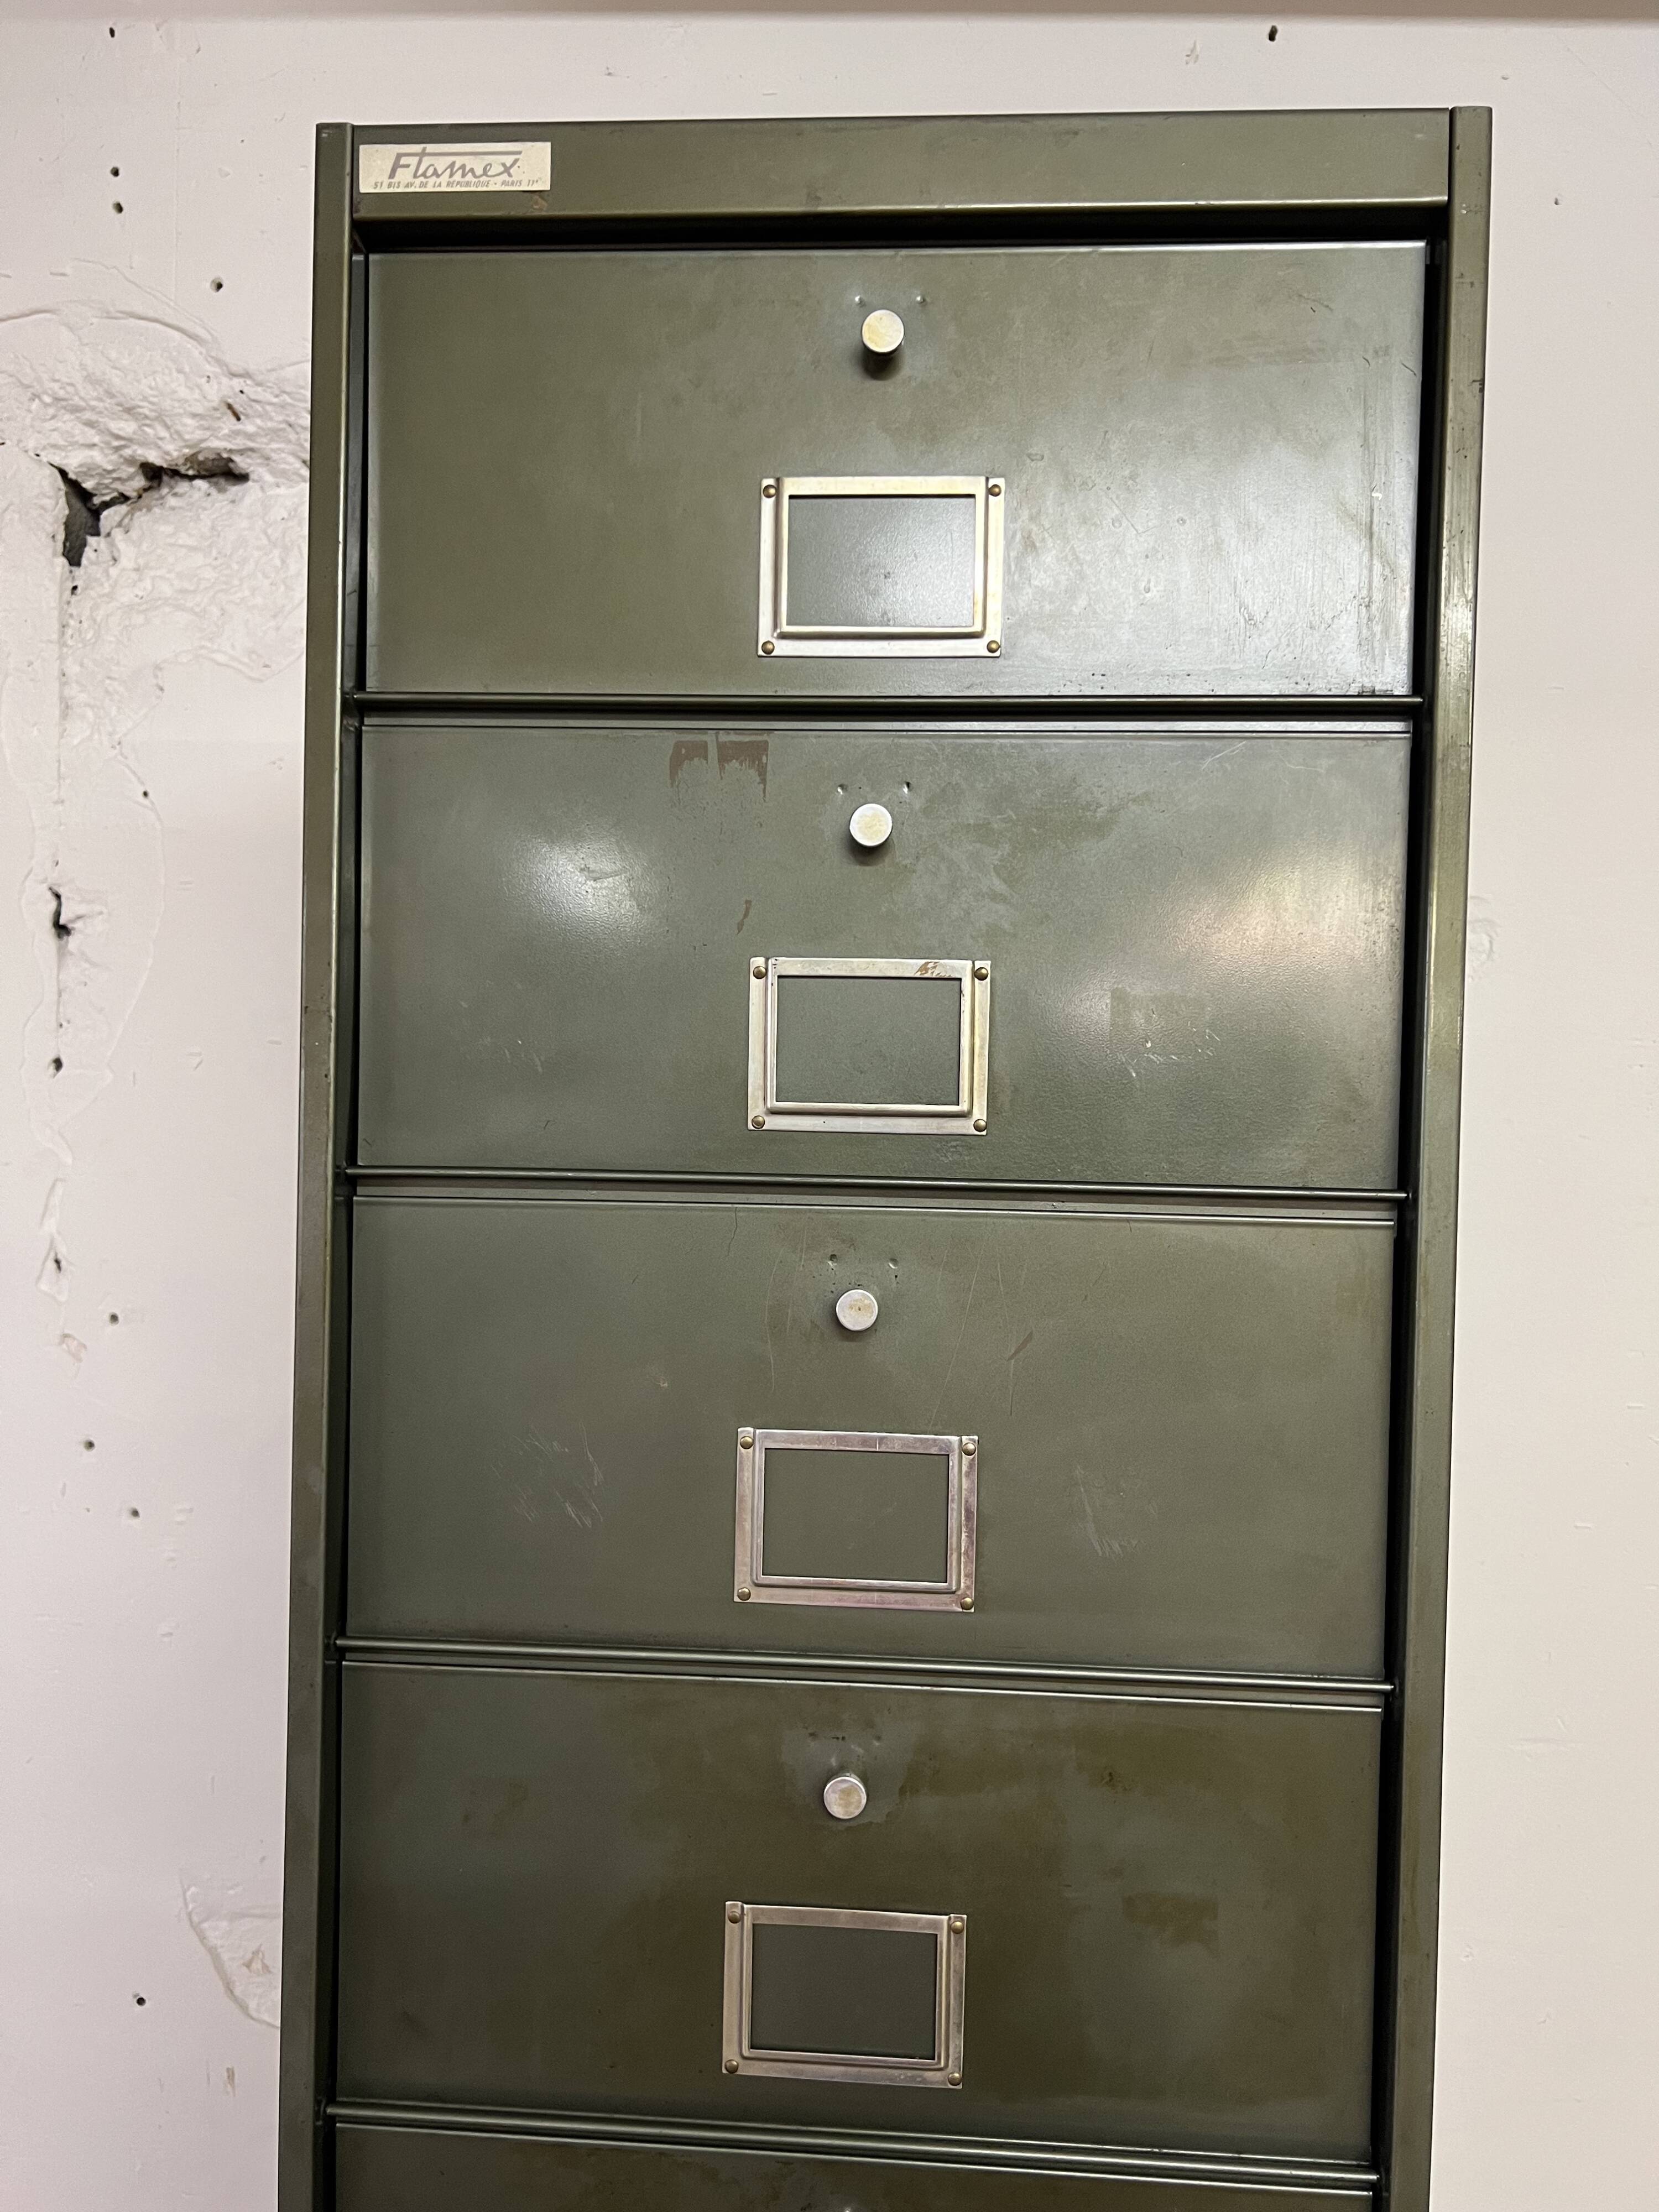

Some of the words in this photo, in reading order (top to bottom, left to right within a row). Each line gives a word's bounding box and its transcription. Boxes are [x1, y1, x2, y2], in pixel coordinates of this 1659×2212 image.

[388, 146, 523, 180] Flamex
[387, 181, 401, 189] BIS
[419, 180, 429, 189] DE
